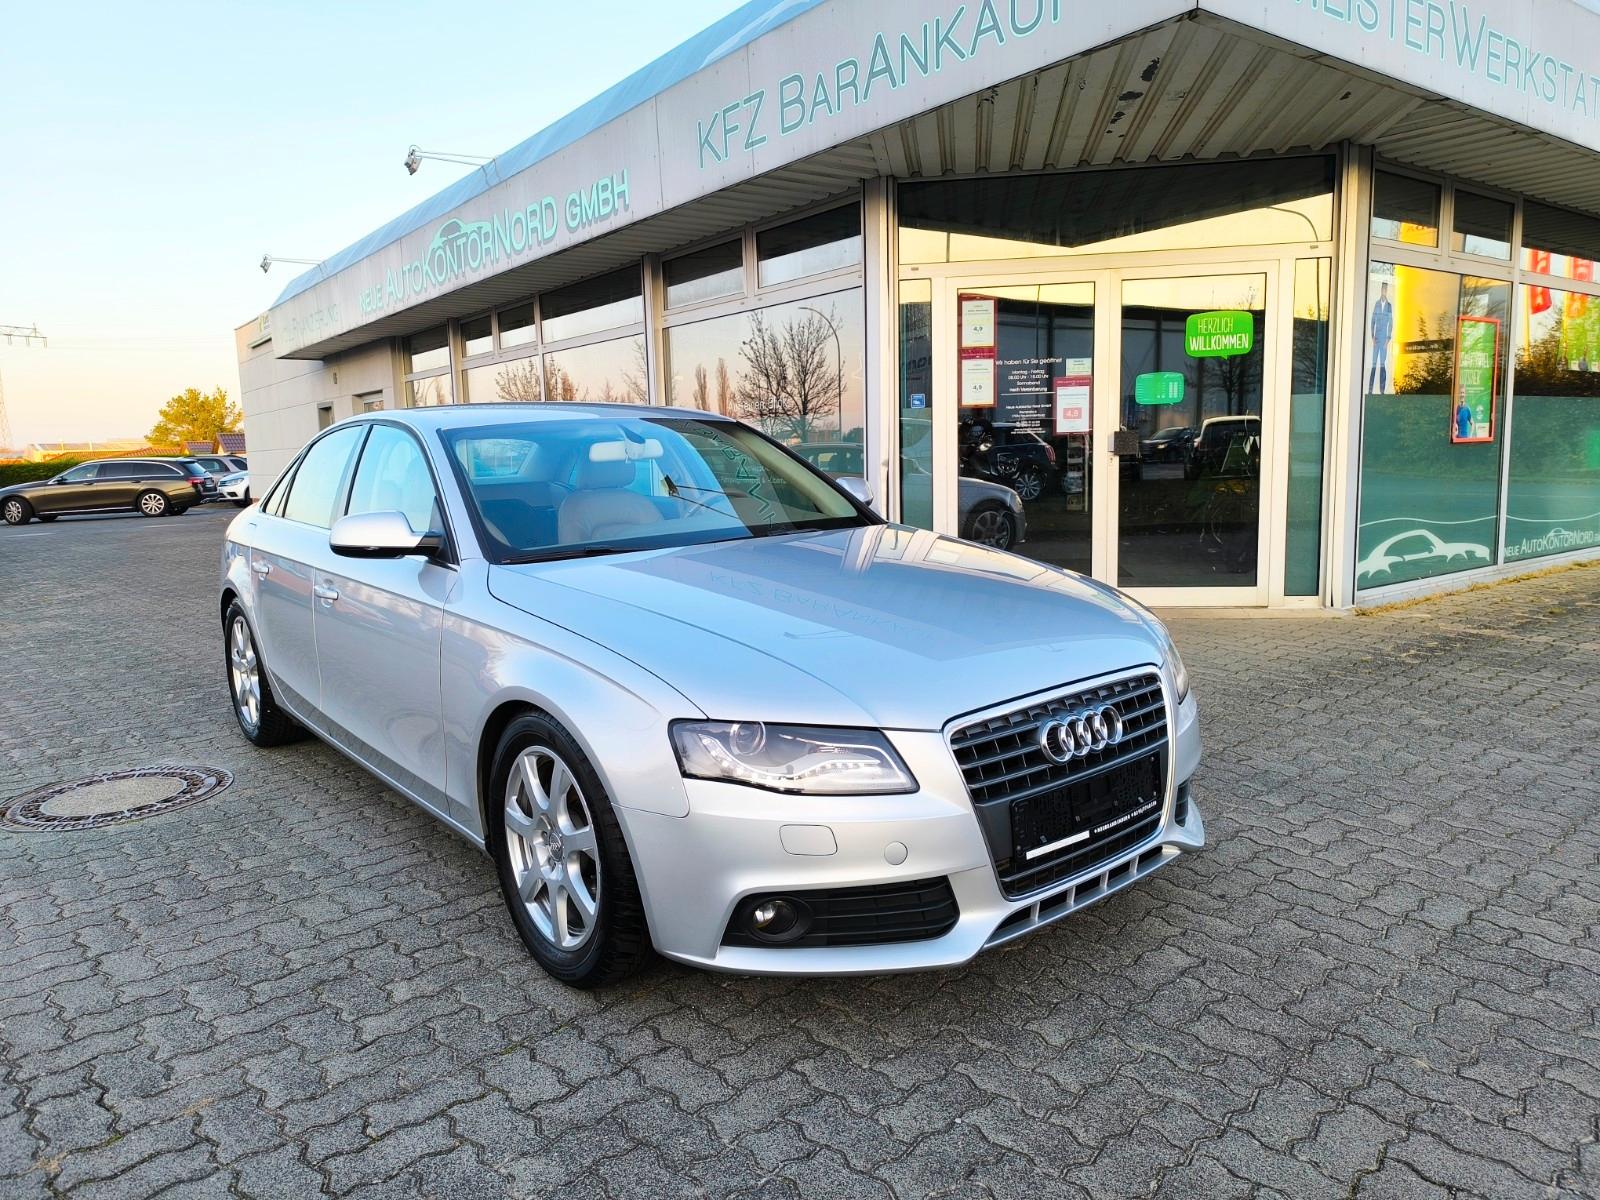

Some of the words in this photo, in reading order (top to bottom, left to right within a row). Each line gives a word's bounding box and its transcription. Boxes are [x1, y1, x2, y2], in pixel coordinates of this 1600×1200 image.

[697, 89, 768, 169] KFZ
[359, 284, 384, 313] NEUE
[564, 168, 630, 233] GMBH
[1189, 333, 1250, 351] WILLKOMMEN
[1198, 317, 1234, 334] HERZLICH
